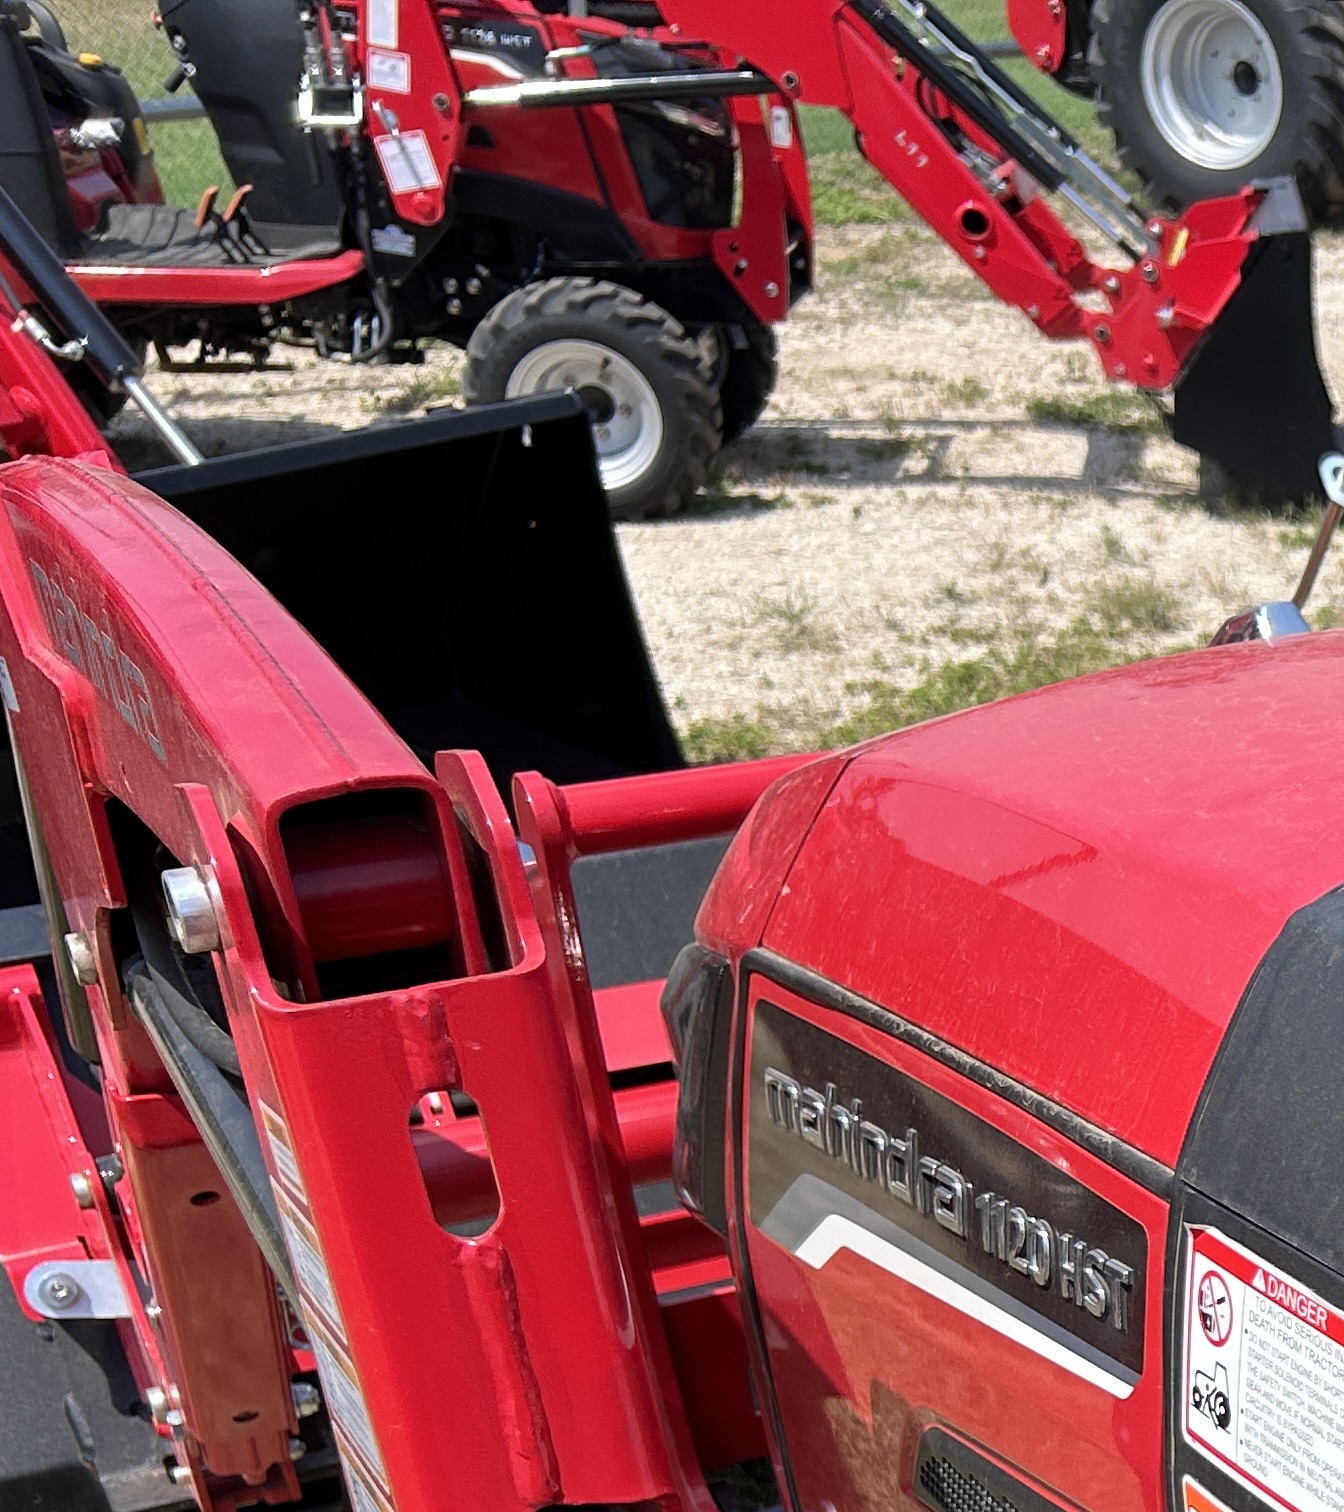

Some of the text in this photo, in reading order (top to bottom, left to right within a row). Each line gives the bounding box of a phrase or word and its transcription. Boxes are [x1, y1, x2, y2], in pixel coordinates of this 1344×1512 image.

[764, 1066, 1135, 1331] mahindra 1120 HST
[1255, 1296, 1265, 1314] TO
[1267, 1303, 1292, 1331] AVOID
[1294, 1321, 1332, 1357] SERIOUS
[1266, 1274, 1329, 1333] DANGER
[1248, 1308, 1275, 1337] DEATH
[1277, 1327, 1302, 1355] FROM
[1304, 1344, 1344, 1383] TRACTOR
